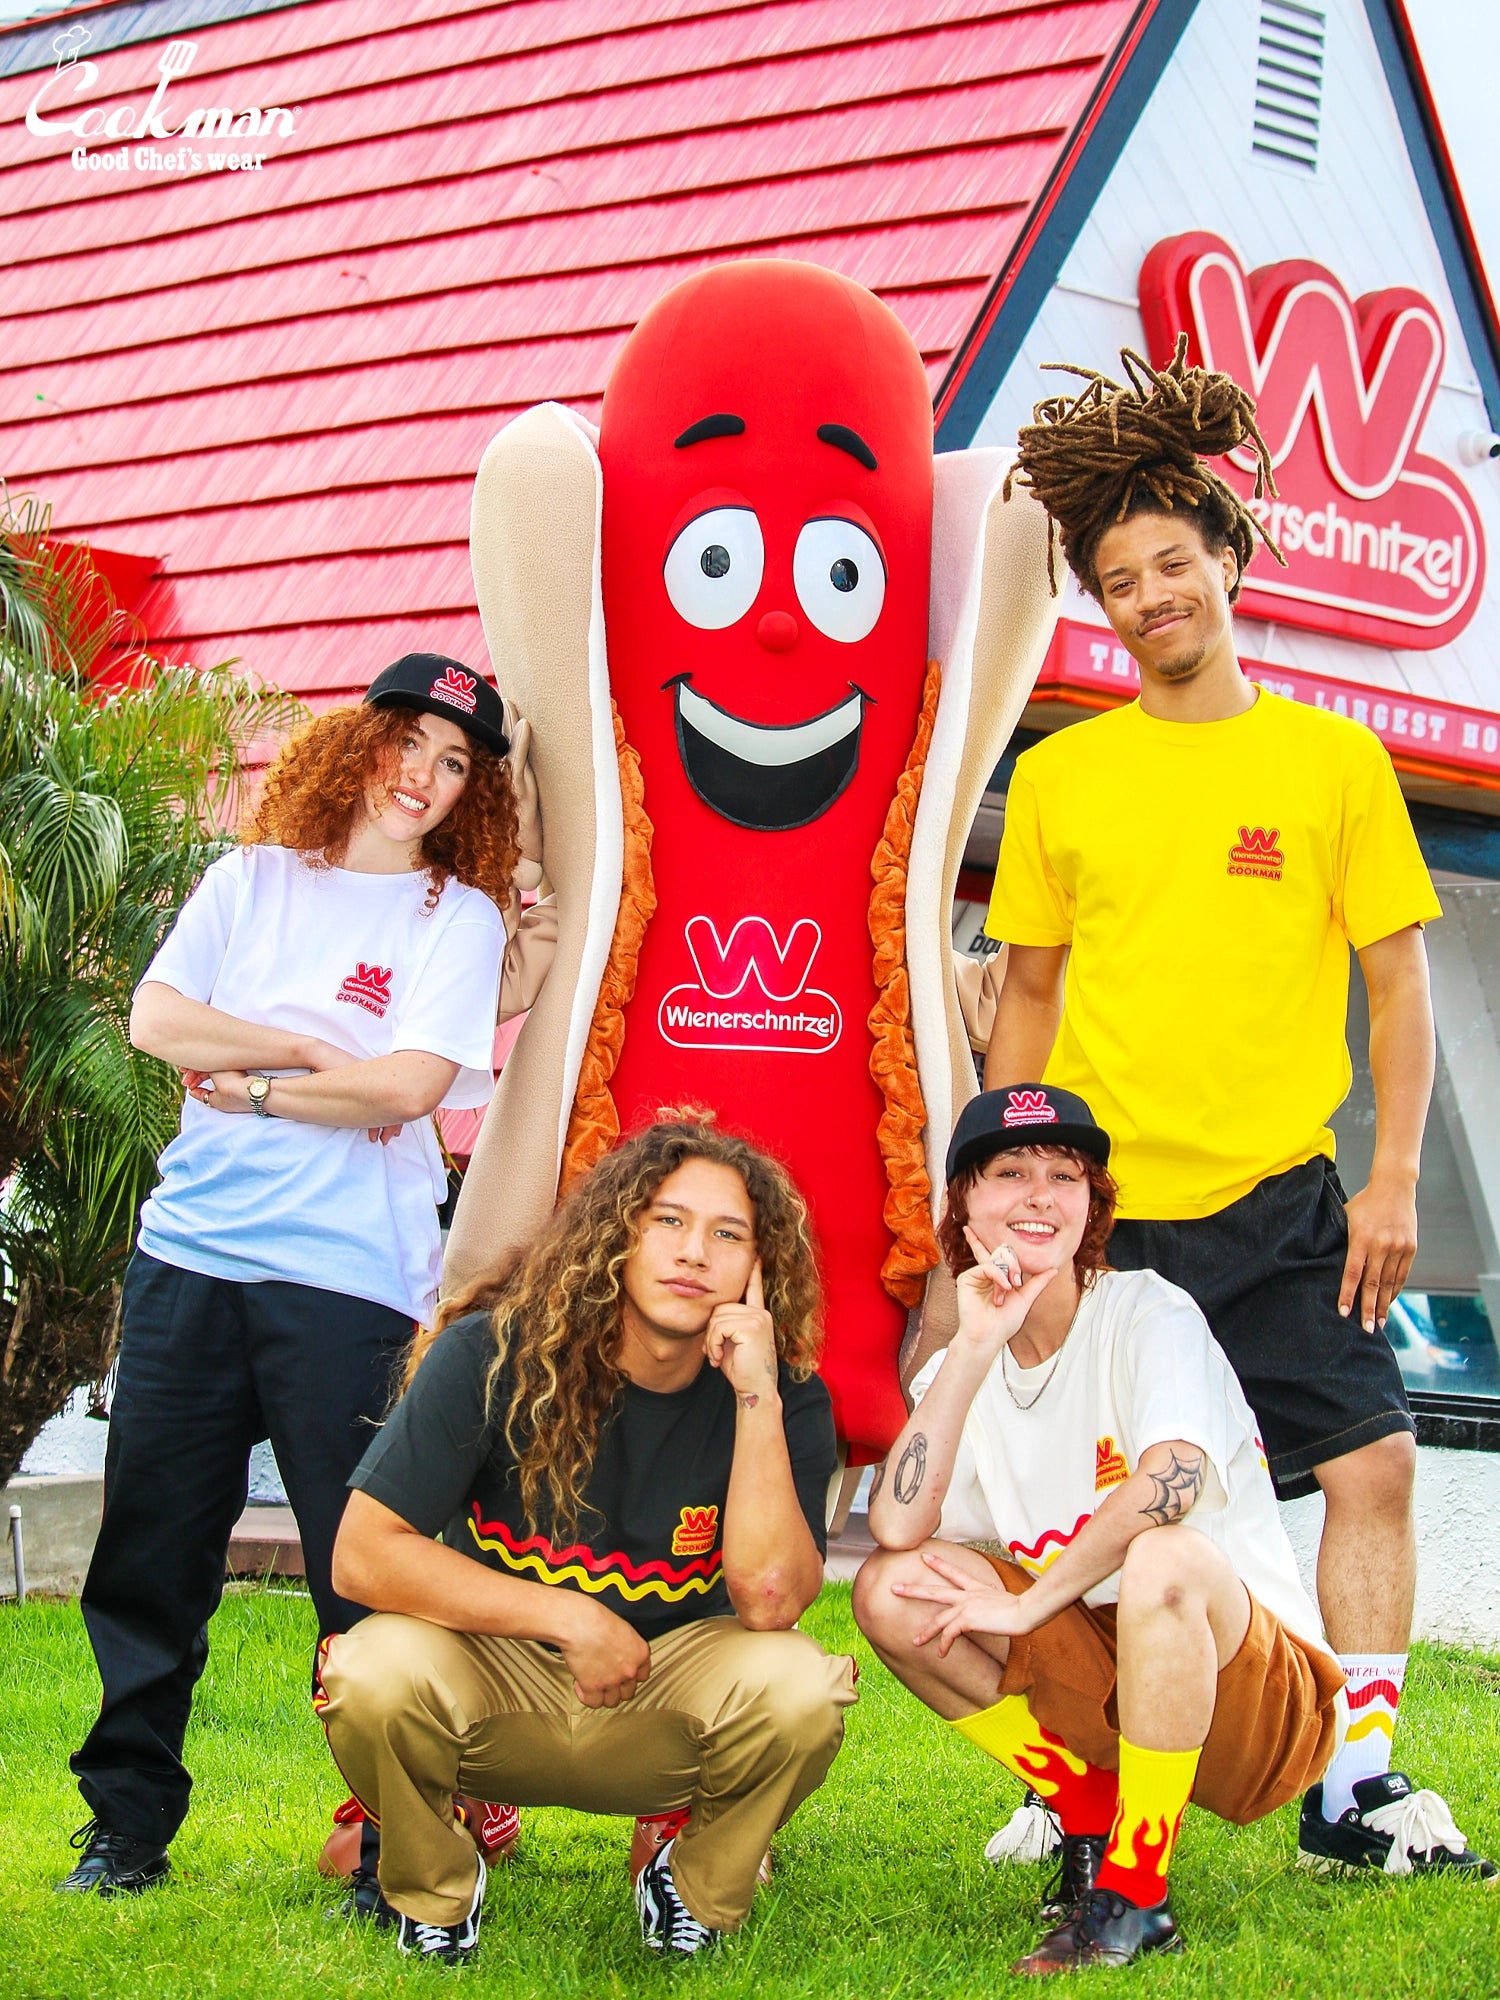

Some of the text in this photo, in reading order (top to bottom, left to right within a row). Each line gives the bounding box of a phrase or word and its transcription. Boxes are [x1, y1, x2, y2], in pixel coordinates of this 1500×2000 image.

[1246, 498, 1463, 600] erschnitzel
[446, 667, 477, 692] W
[1090, 642, 1141, 679] TH
[1315, 690, 1446, 742] LARGEST
[430, 690, 474, 714] COOKMAN
[1239, 826, 1280, 852] W
[1228, 866, 1281, 880] COOKMAN
[685, 915, 822, 1001] W
[356, 962, 393, 988] W
[336, 992, 386, 1018] COOKMAN
[666, 1005, 834, 1037] Wienerschnitzel
[1009, 1091, 1046, 1110] W
[683, 1506, 717, 1531] W
